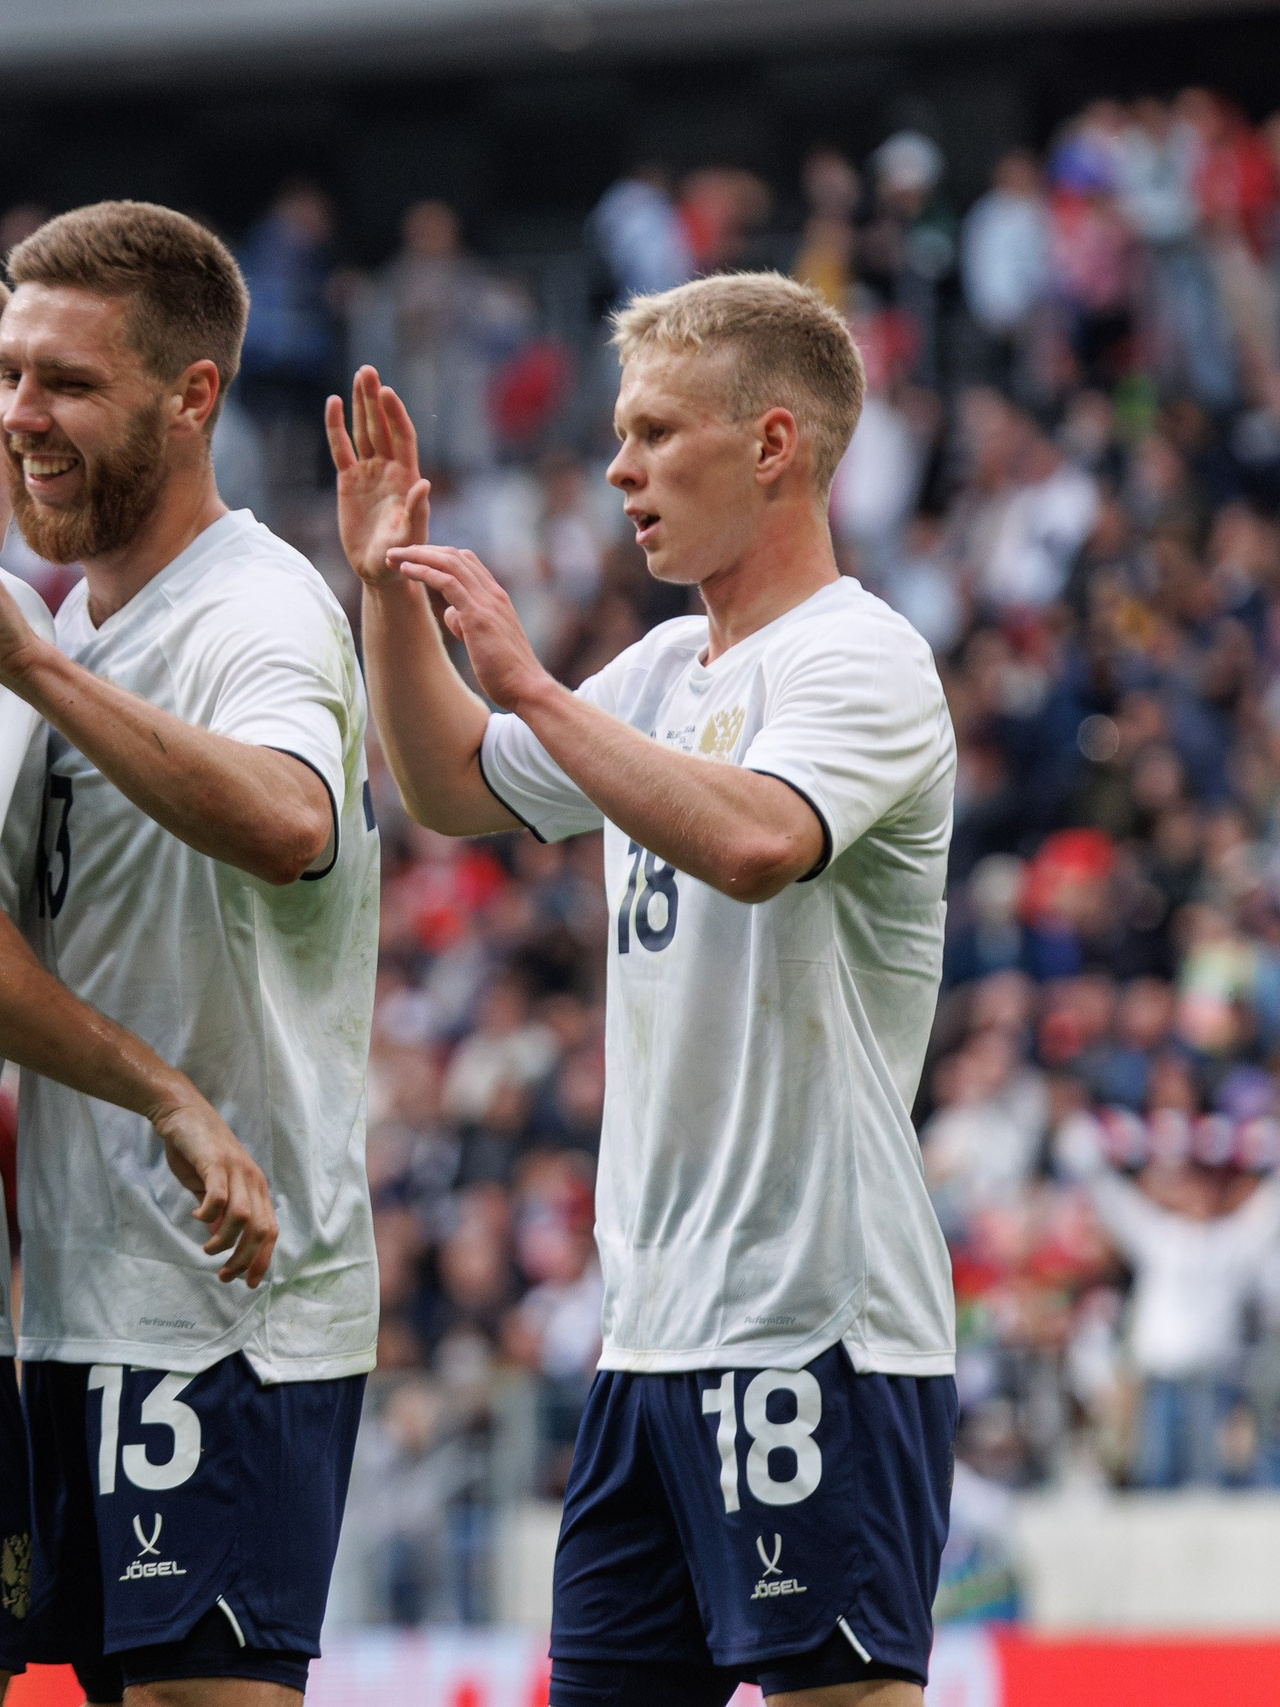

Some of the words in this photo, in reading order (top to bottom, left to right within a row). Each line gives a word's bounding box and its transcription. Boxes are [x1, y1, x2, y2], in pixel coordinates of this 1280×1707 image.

[617, 837, 679, 955] 18
[87, 1364, 202, 1496] 13
[702, 1367, 822, 1514] 18
[119, 1560, 188, 1582] JÖGEL
[750, 1578, 808, 1600] JÖGEL
